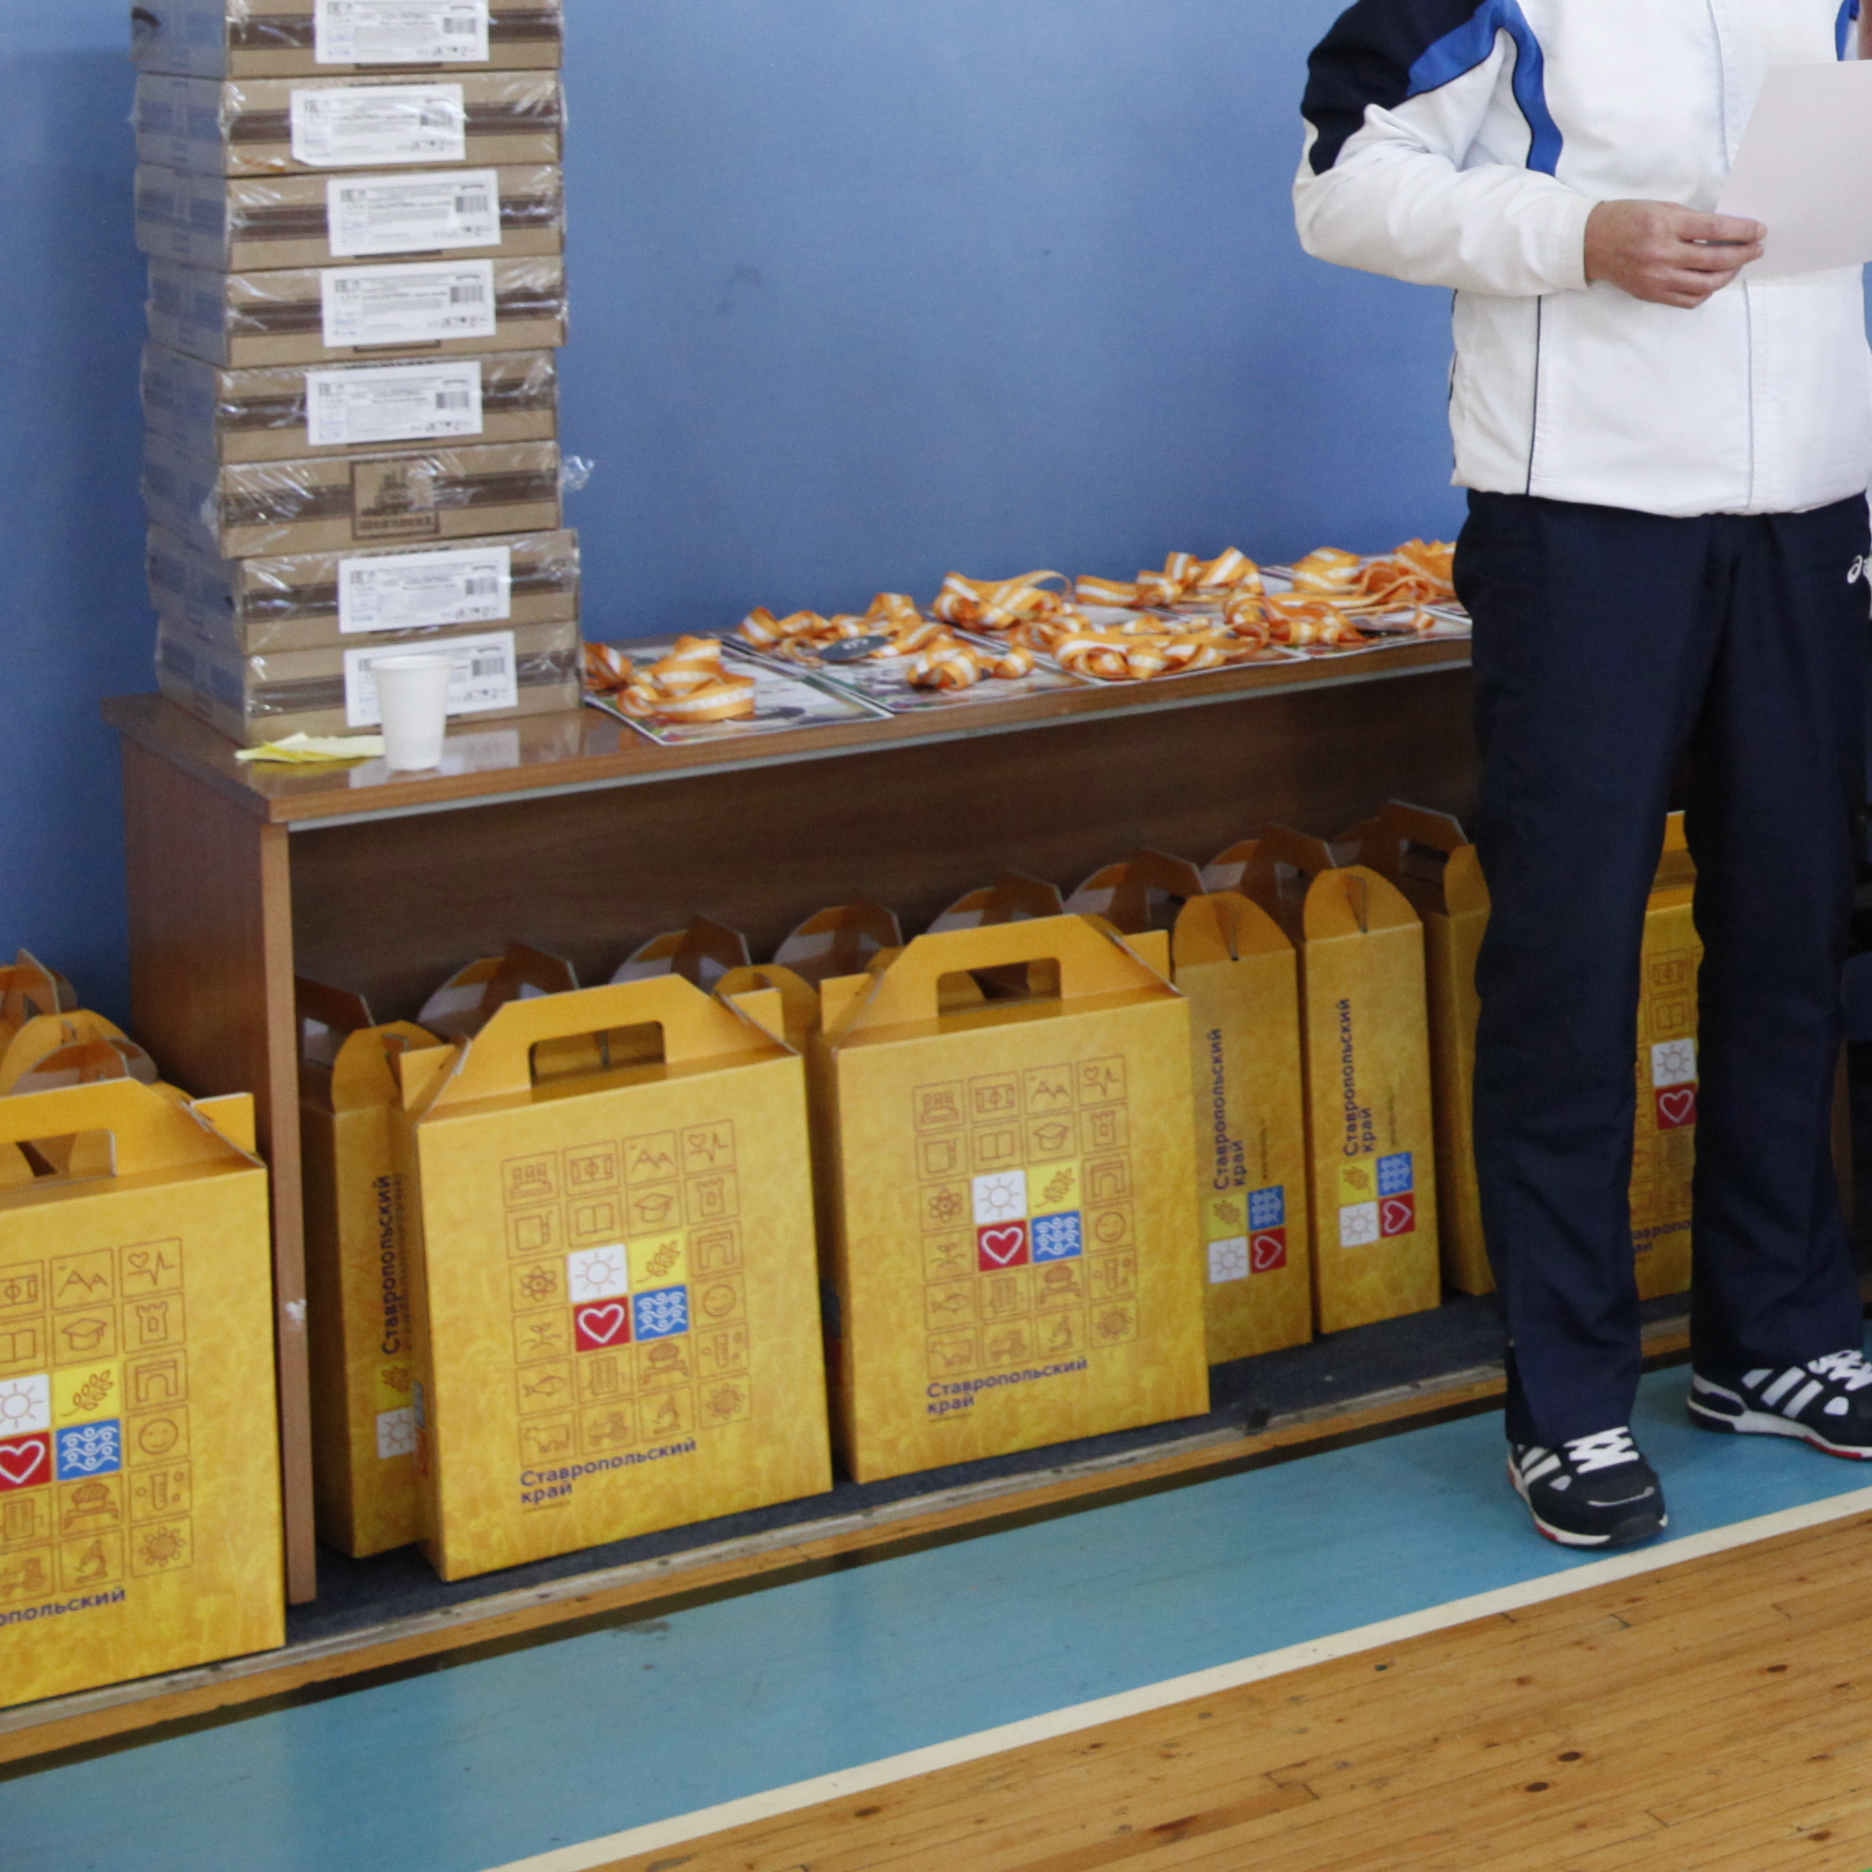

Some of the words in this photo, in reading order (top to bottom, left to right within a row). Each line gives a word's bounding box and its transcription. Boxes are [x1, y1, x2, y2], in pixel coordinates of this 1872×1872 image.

[1335, 997, 1360, 1157] Ставропольский
[1205, 1027, 1230, 1191] Ставропольский
[925, 1355, 1089, 1399] Ставропольский
[926, 1392, 975, 1416] край
[519, 1436, 697, 1488] Ставропольский
[519, 1479, 573, 1506] край
